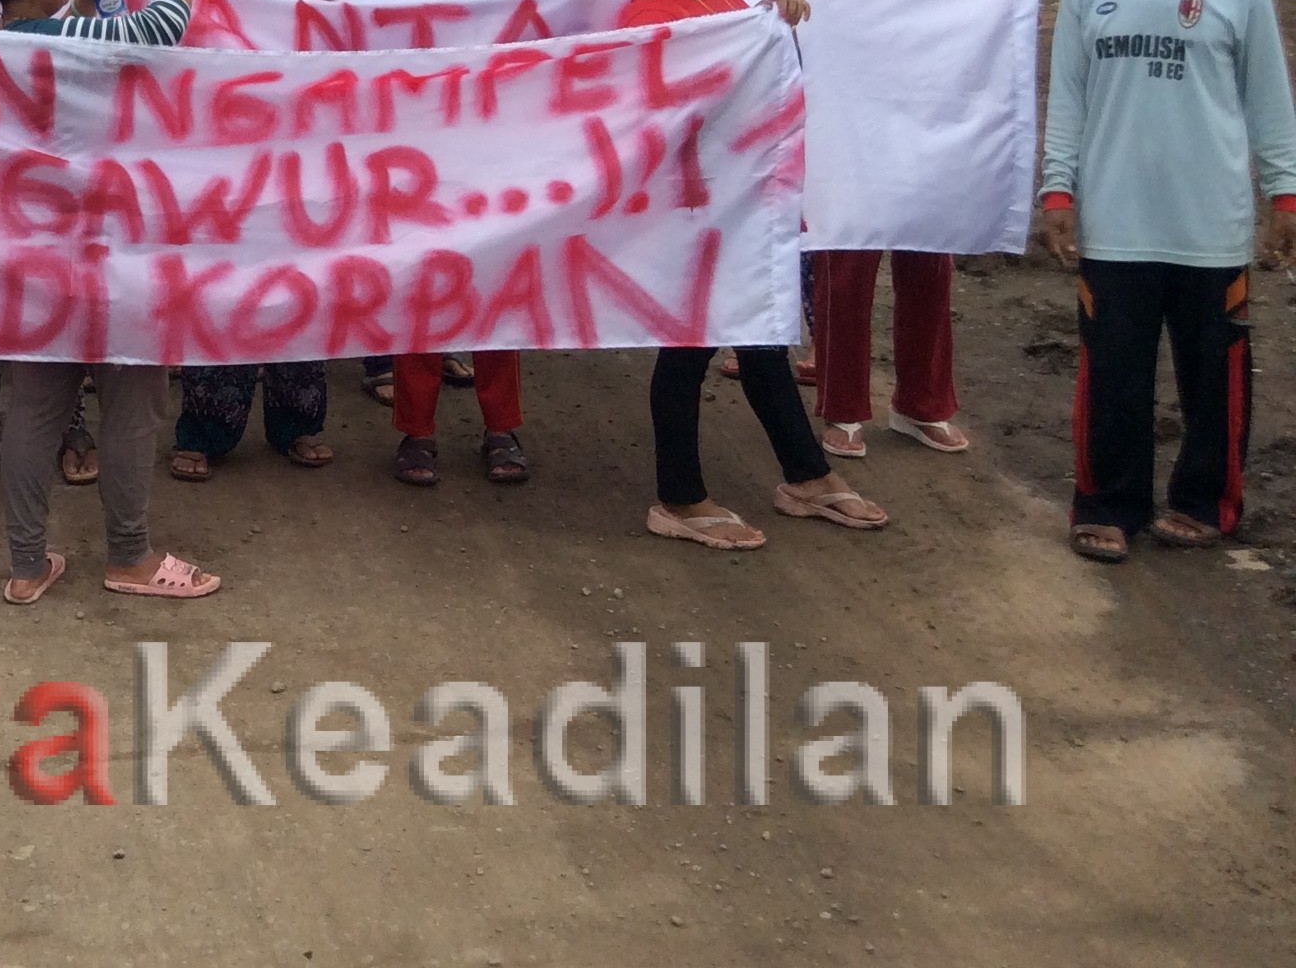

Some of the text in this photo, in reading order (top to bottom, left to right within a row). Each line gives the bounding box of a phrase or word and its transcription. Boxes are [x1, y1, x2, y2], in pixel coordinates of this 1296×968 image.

[1147, 61, 1185, 81] 18 EC
[151, 228, 720, 366] KORBAN
